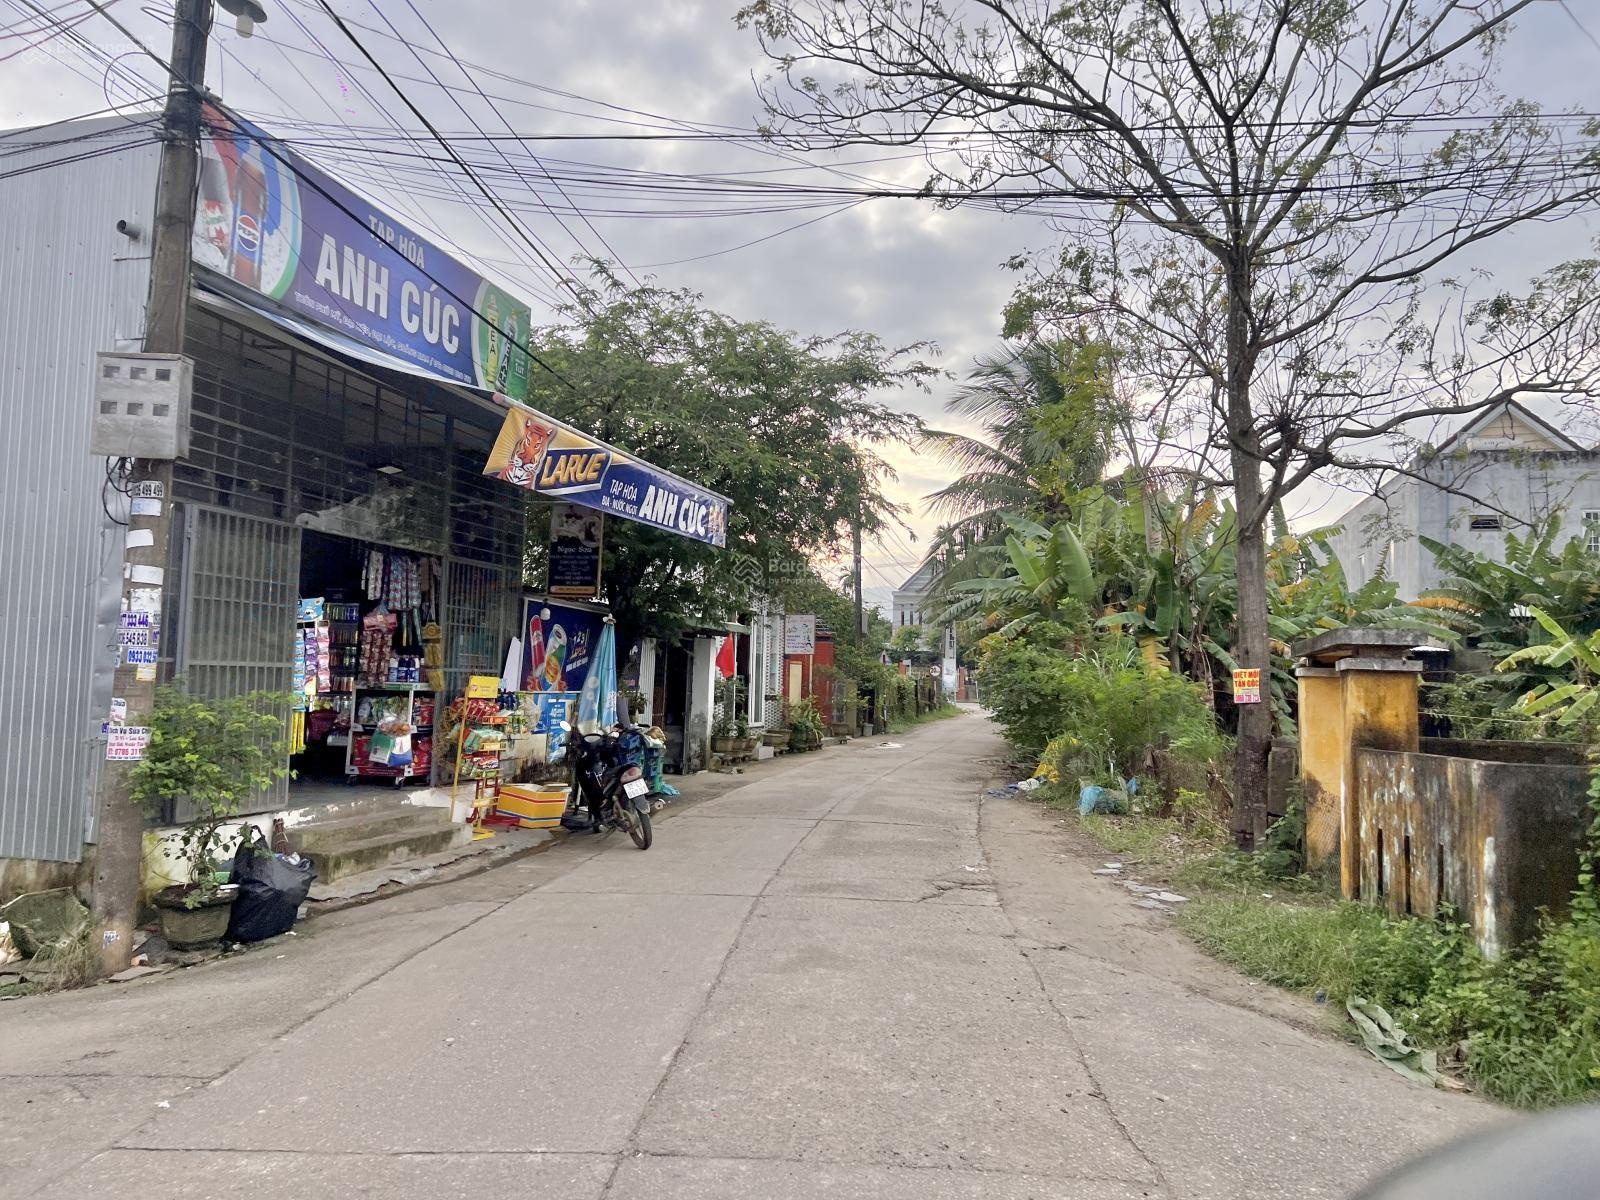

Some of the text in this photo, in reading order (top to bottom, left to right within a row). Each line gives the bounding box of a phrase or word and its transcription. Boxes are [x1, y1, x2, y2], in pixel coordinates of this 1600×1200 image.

[399, 234, 425, 269] HÓA
[315, 233, 389, 319] ANH
[401, 279, 460, 354] CÚC
[539, 453, 607, 487] LARUE
[609, 479, 638, 502] TẠP HÓA
[638, 484, 707, 537] ANH CÚC
